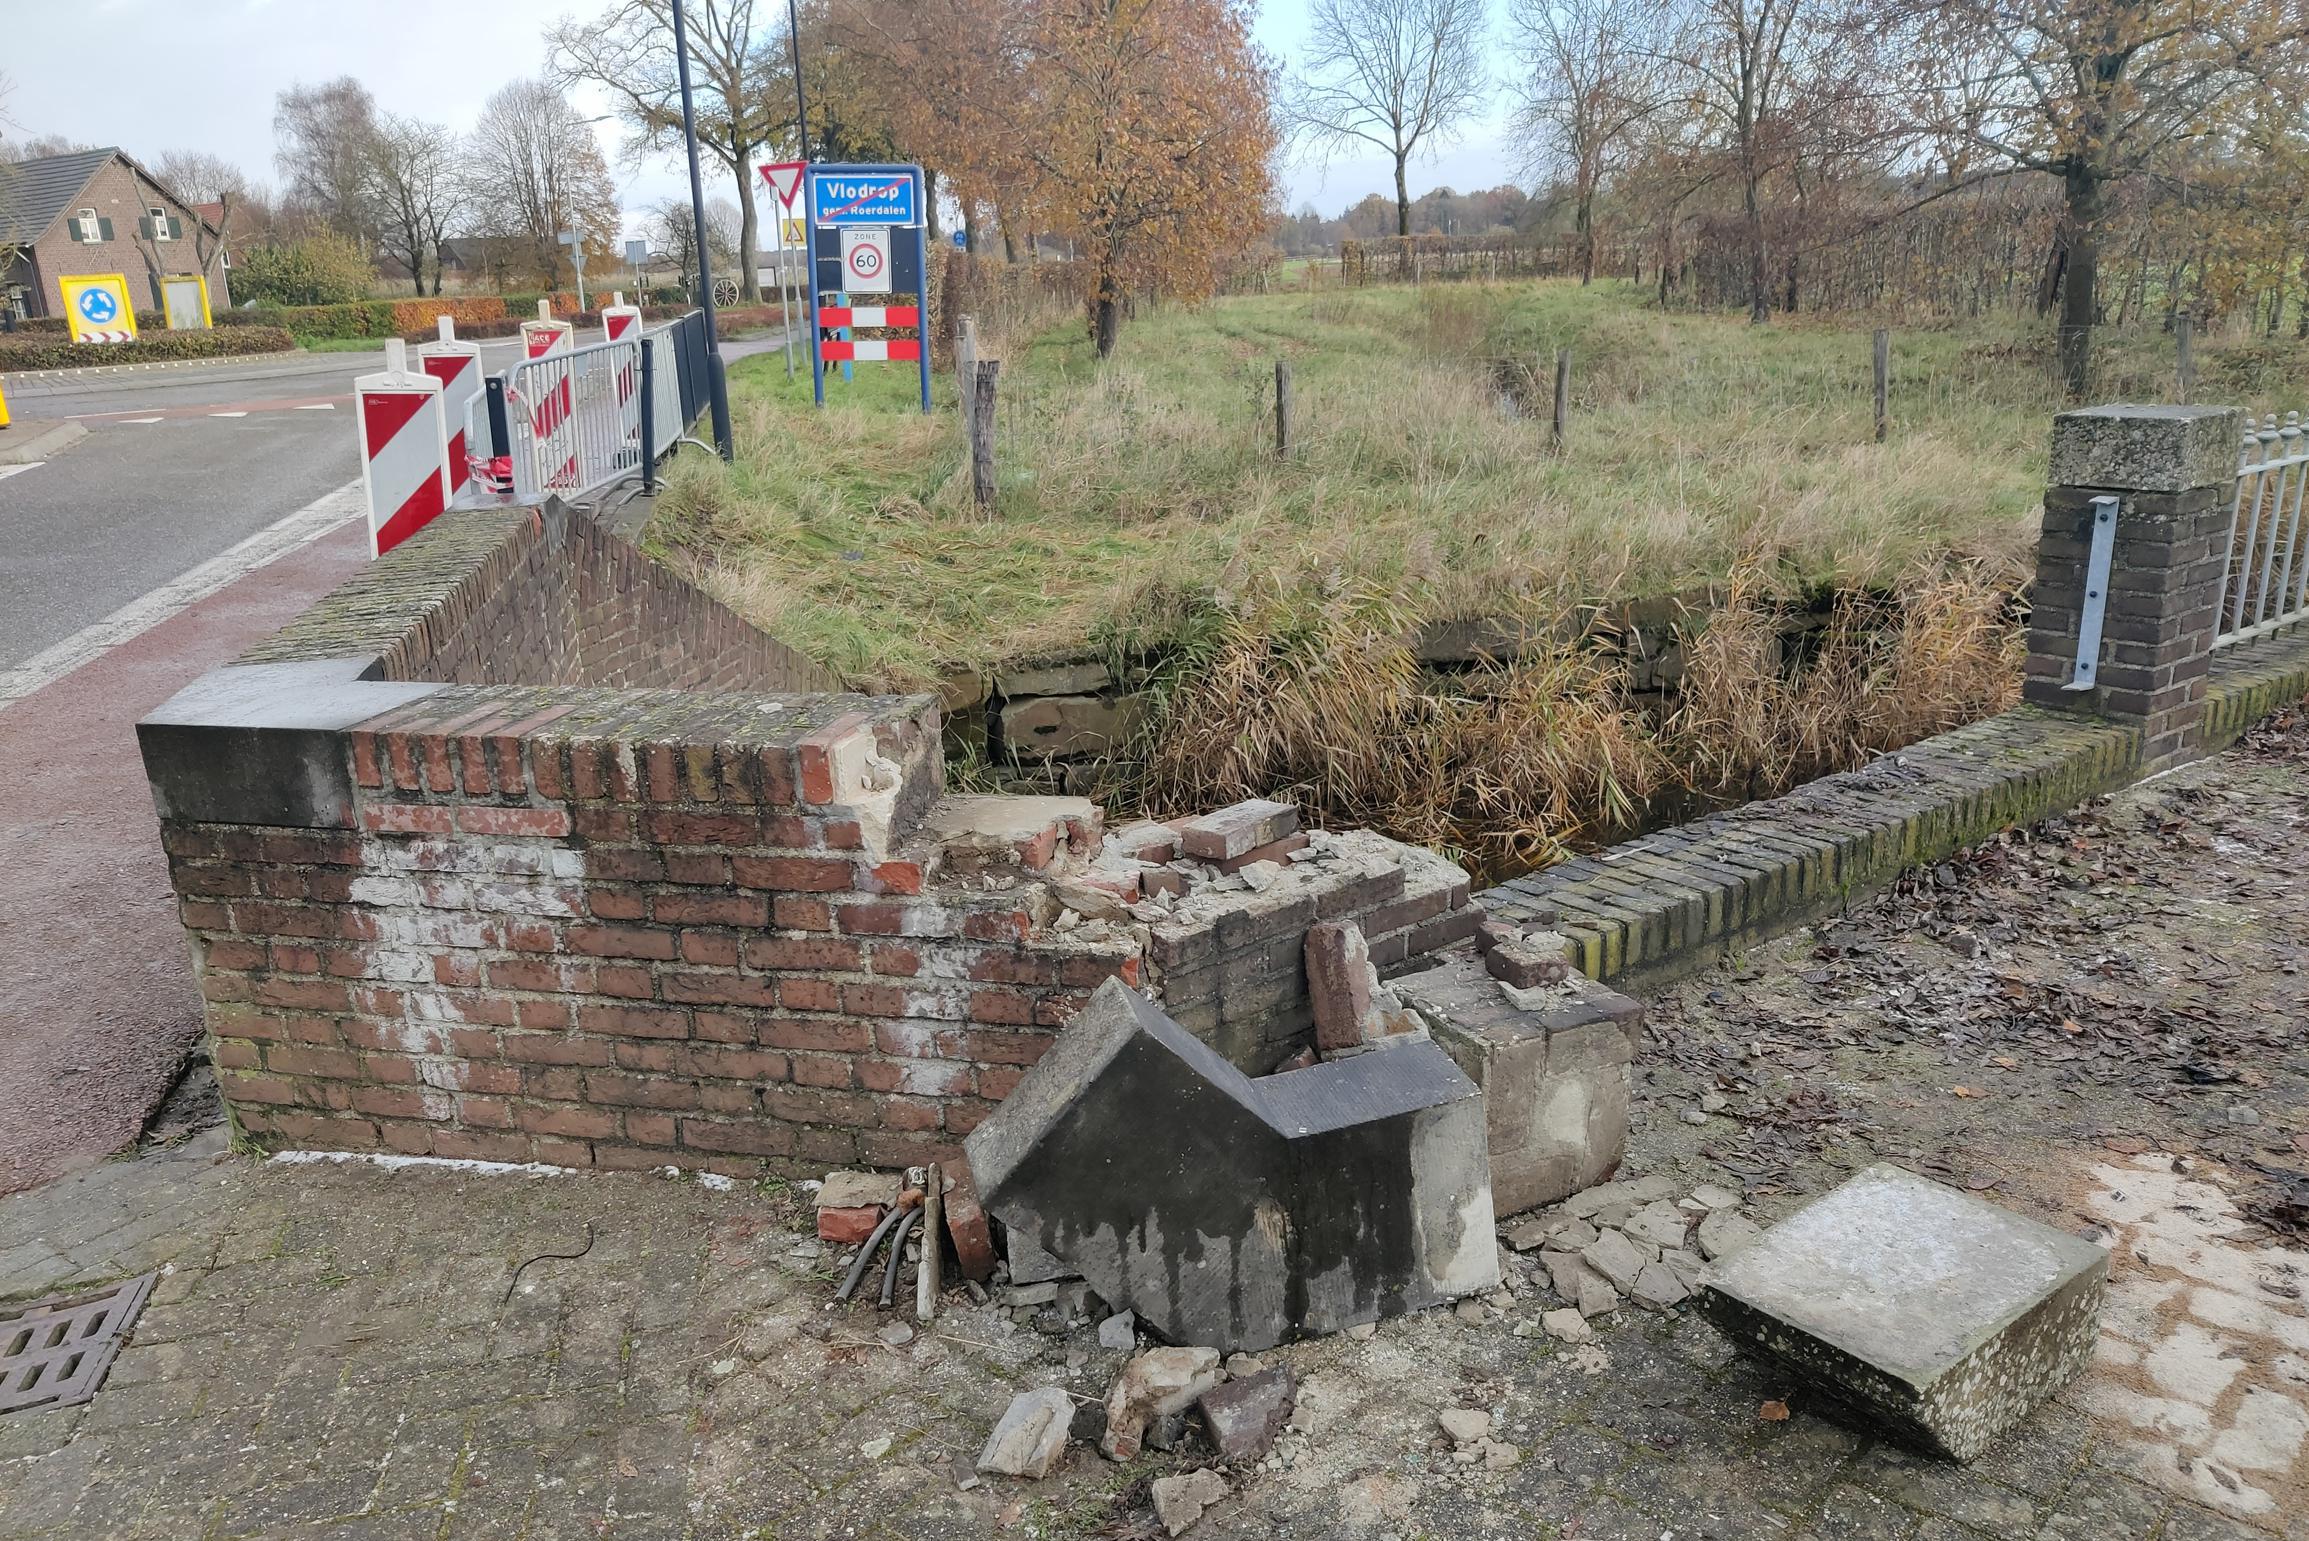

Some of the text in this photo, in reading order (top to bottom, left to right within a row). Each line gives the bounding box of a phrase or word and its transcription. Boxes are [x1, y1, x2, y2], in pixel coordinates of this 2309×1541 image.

[826, 182, 899, 202] Vlodrop
[850, 205, 906, 215] Roerdalen
[856, 254, 877, 268] 60
